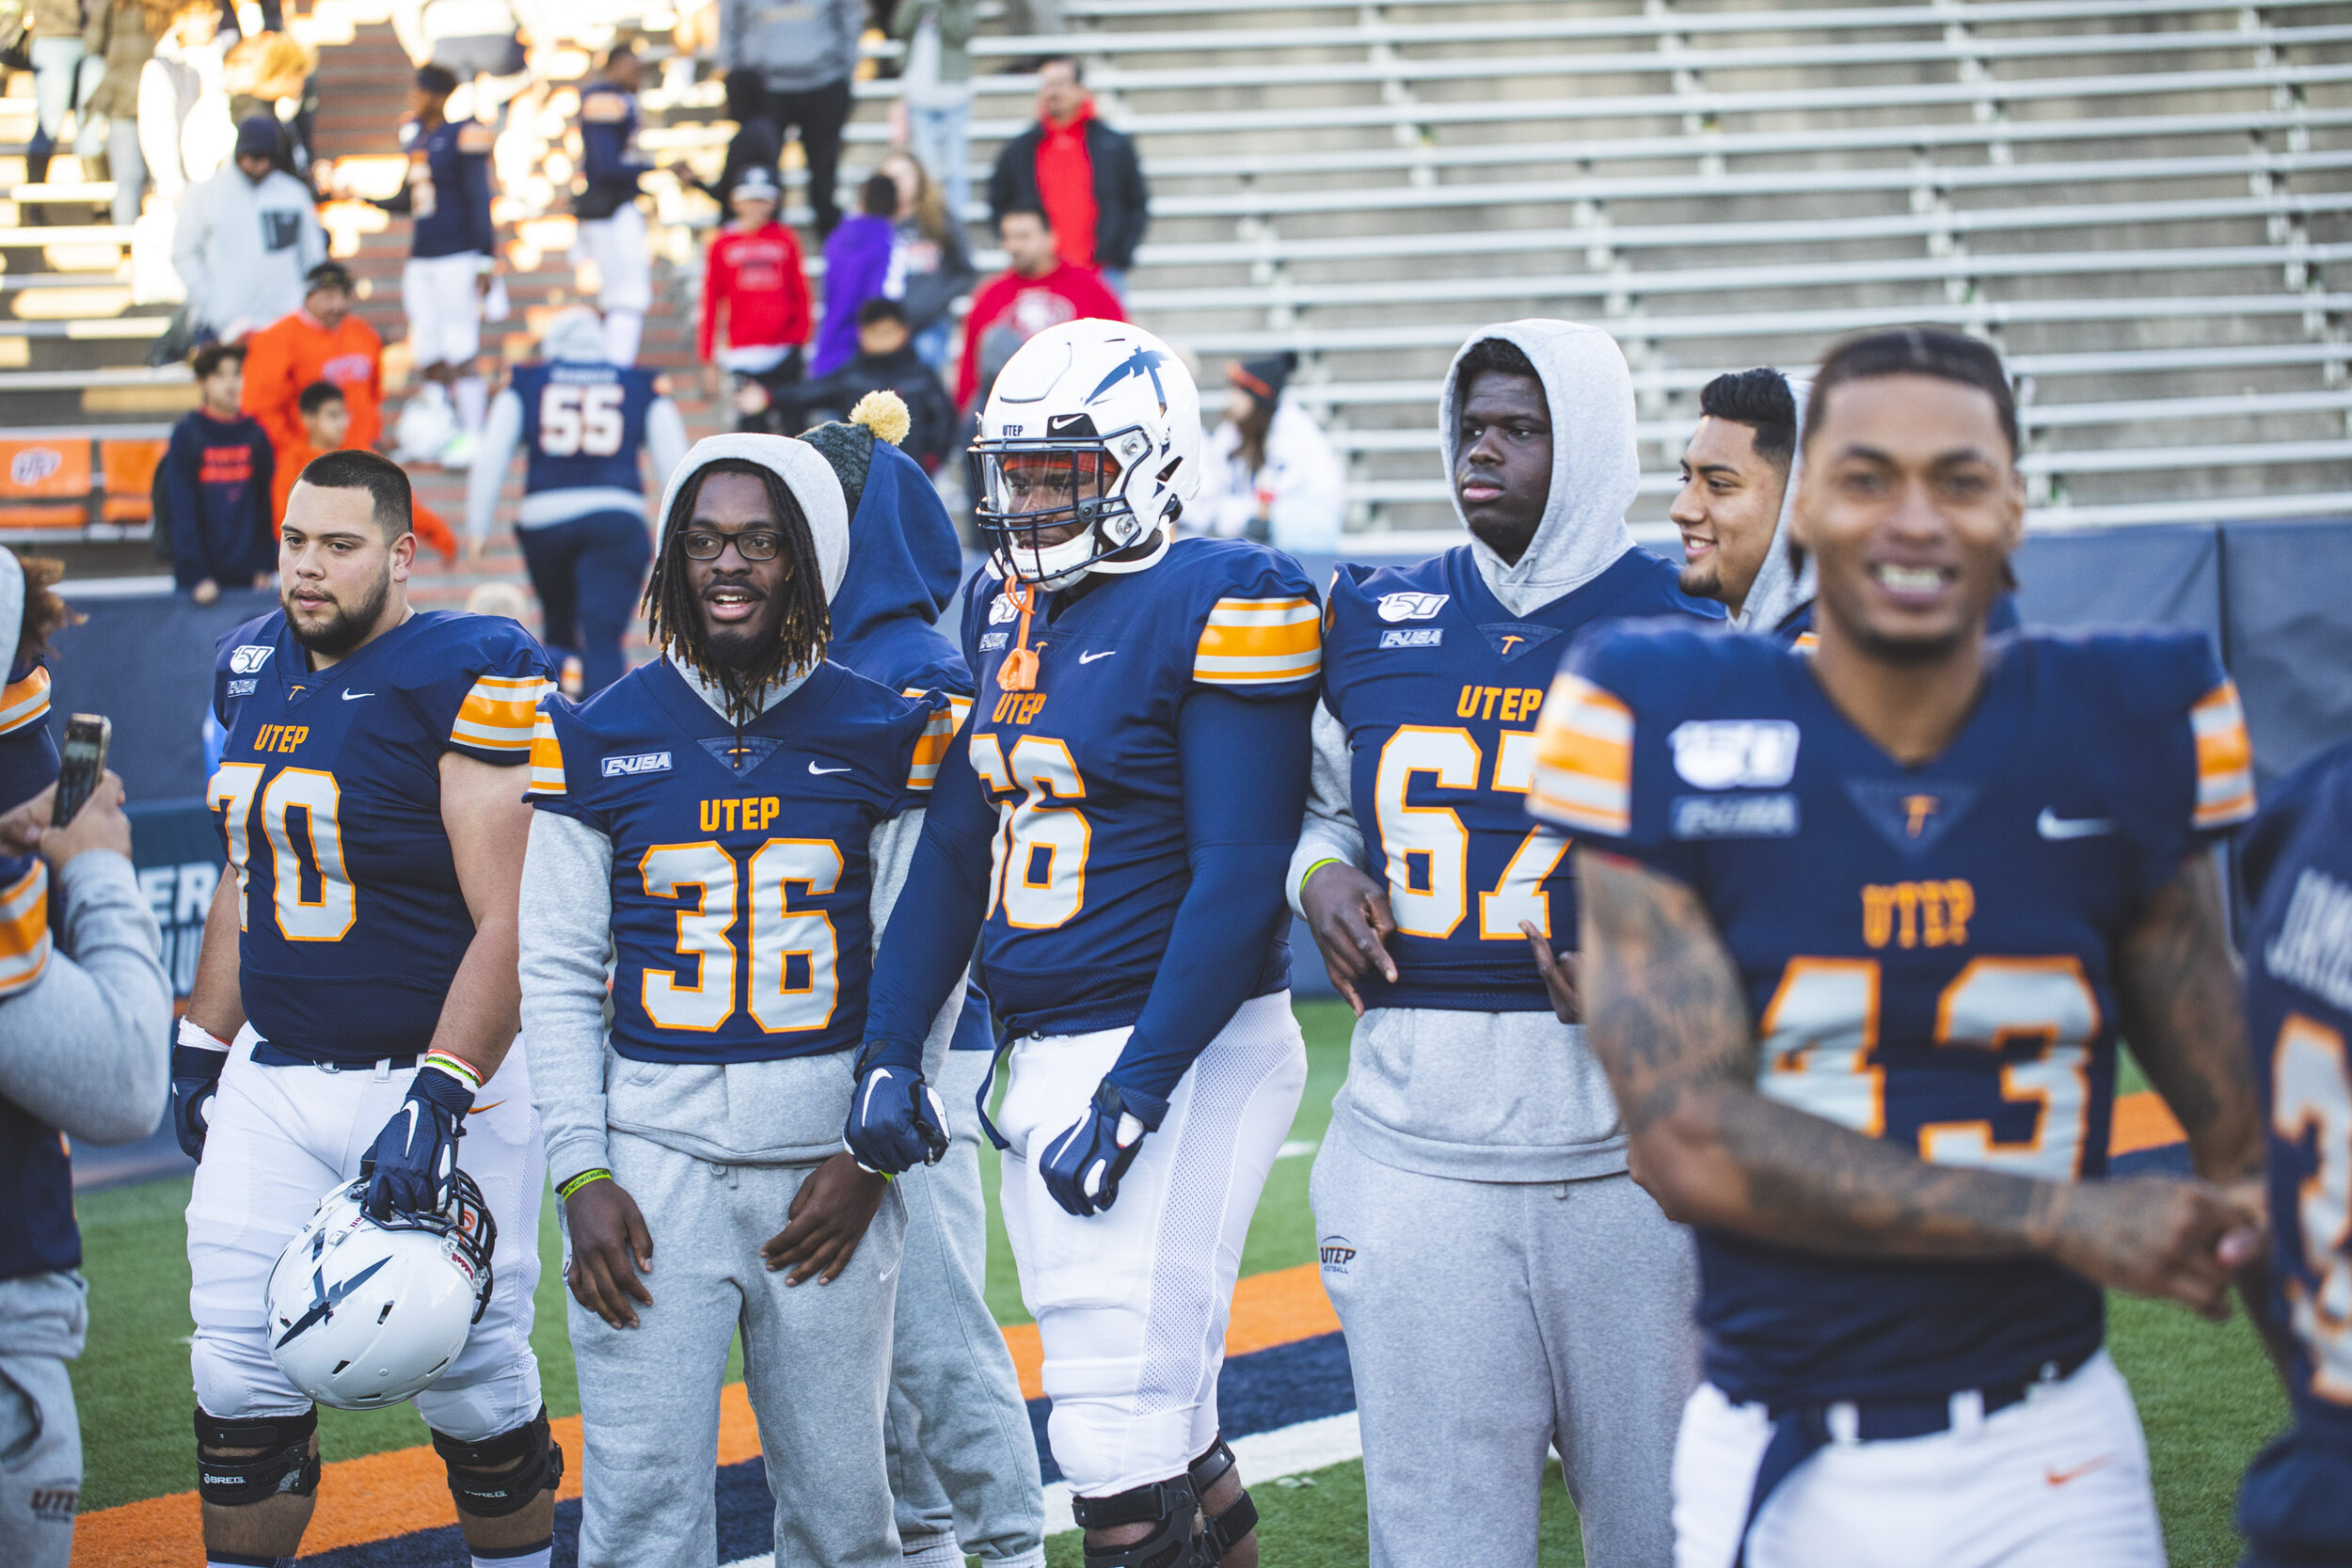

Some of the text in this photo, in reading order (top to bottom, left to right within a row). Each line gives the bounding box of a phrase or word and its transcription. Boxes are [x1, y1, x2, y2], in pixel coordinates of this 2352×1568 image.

[538, 383, 625, 457] 55
[1003, 425, 1024, 436] UTEP
[1377, 592, 1450, 622] 150
[230, 645, 275, 673] 150
[992, 693, 1046, 724] UTEP
[1456, 685, 1543, 721] UTEP
[254, 724, 309, 752] UTEP
[700, 797, 780, 832] UTEP
[969, 733, 1091, 929] 66
[1375, 724, 1572, 940] 67
[207, 762, 357, 942] 70
[1861, 879, 1975, 949] UTEP
[638, 838, 844, 1034] 36
[1757, 954, 2102, 1183] 43
[1320, 1246, 1357, 1264] UTEP
